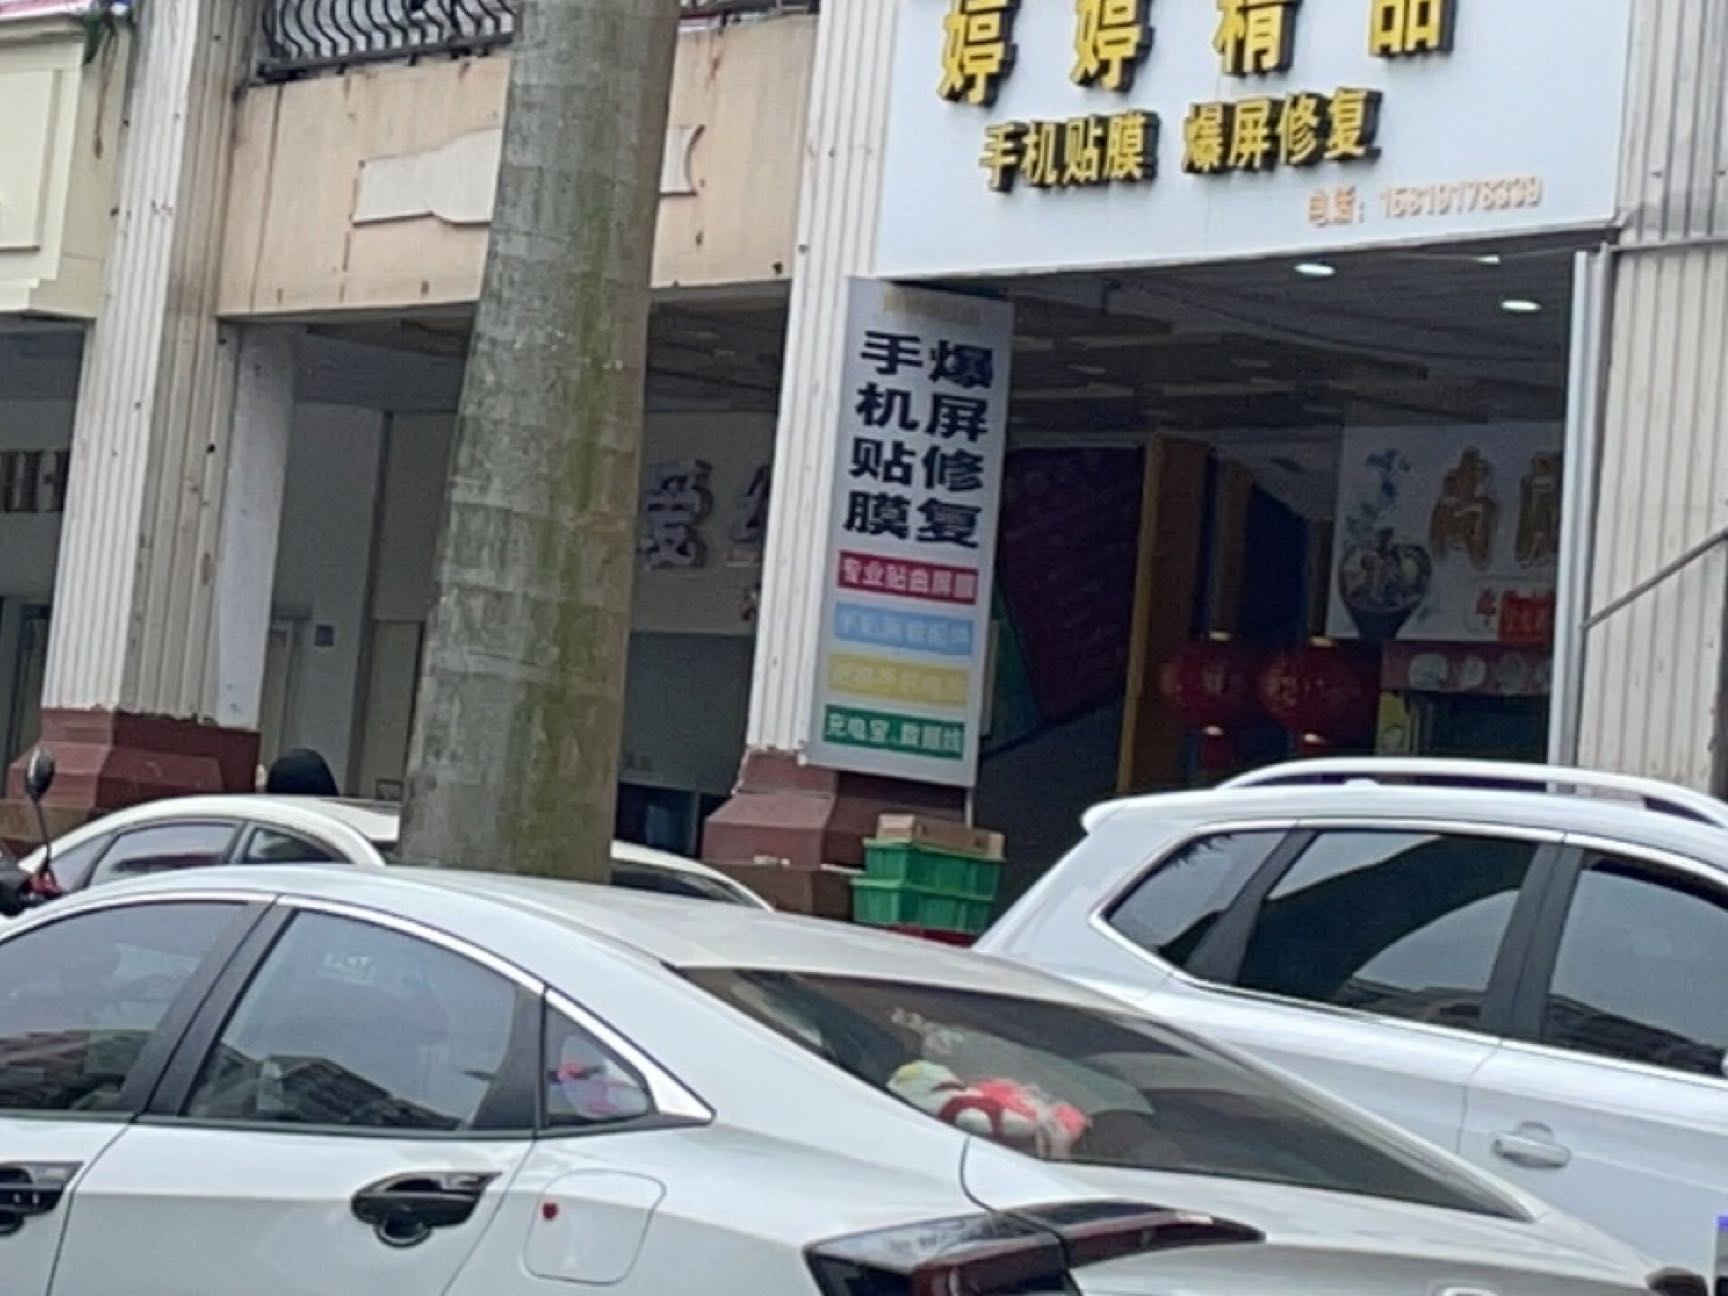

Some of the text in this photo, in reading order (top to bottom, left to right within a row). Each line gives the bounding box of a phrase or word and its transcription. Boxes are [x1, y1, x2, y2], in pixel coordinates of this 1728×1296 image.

[979, 87, 1383, 193] 手机贴膜 爆屏修复
[844, 330, 924, 541] 手机贴膜
[915, 339, 993, 549] 爆屏修复
